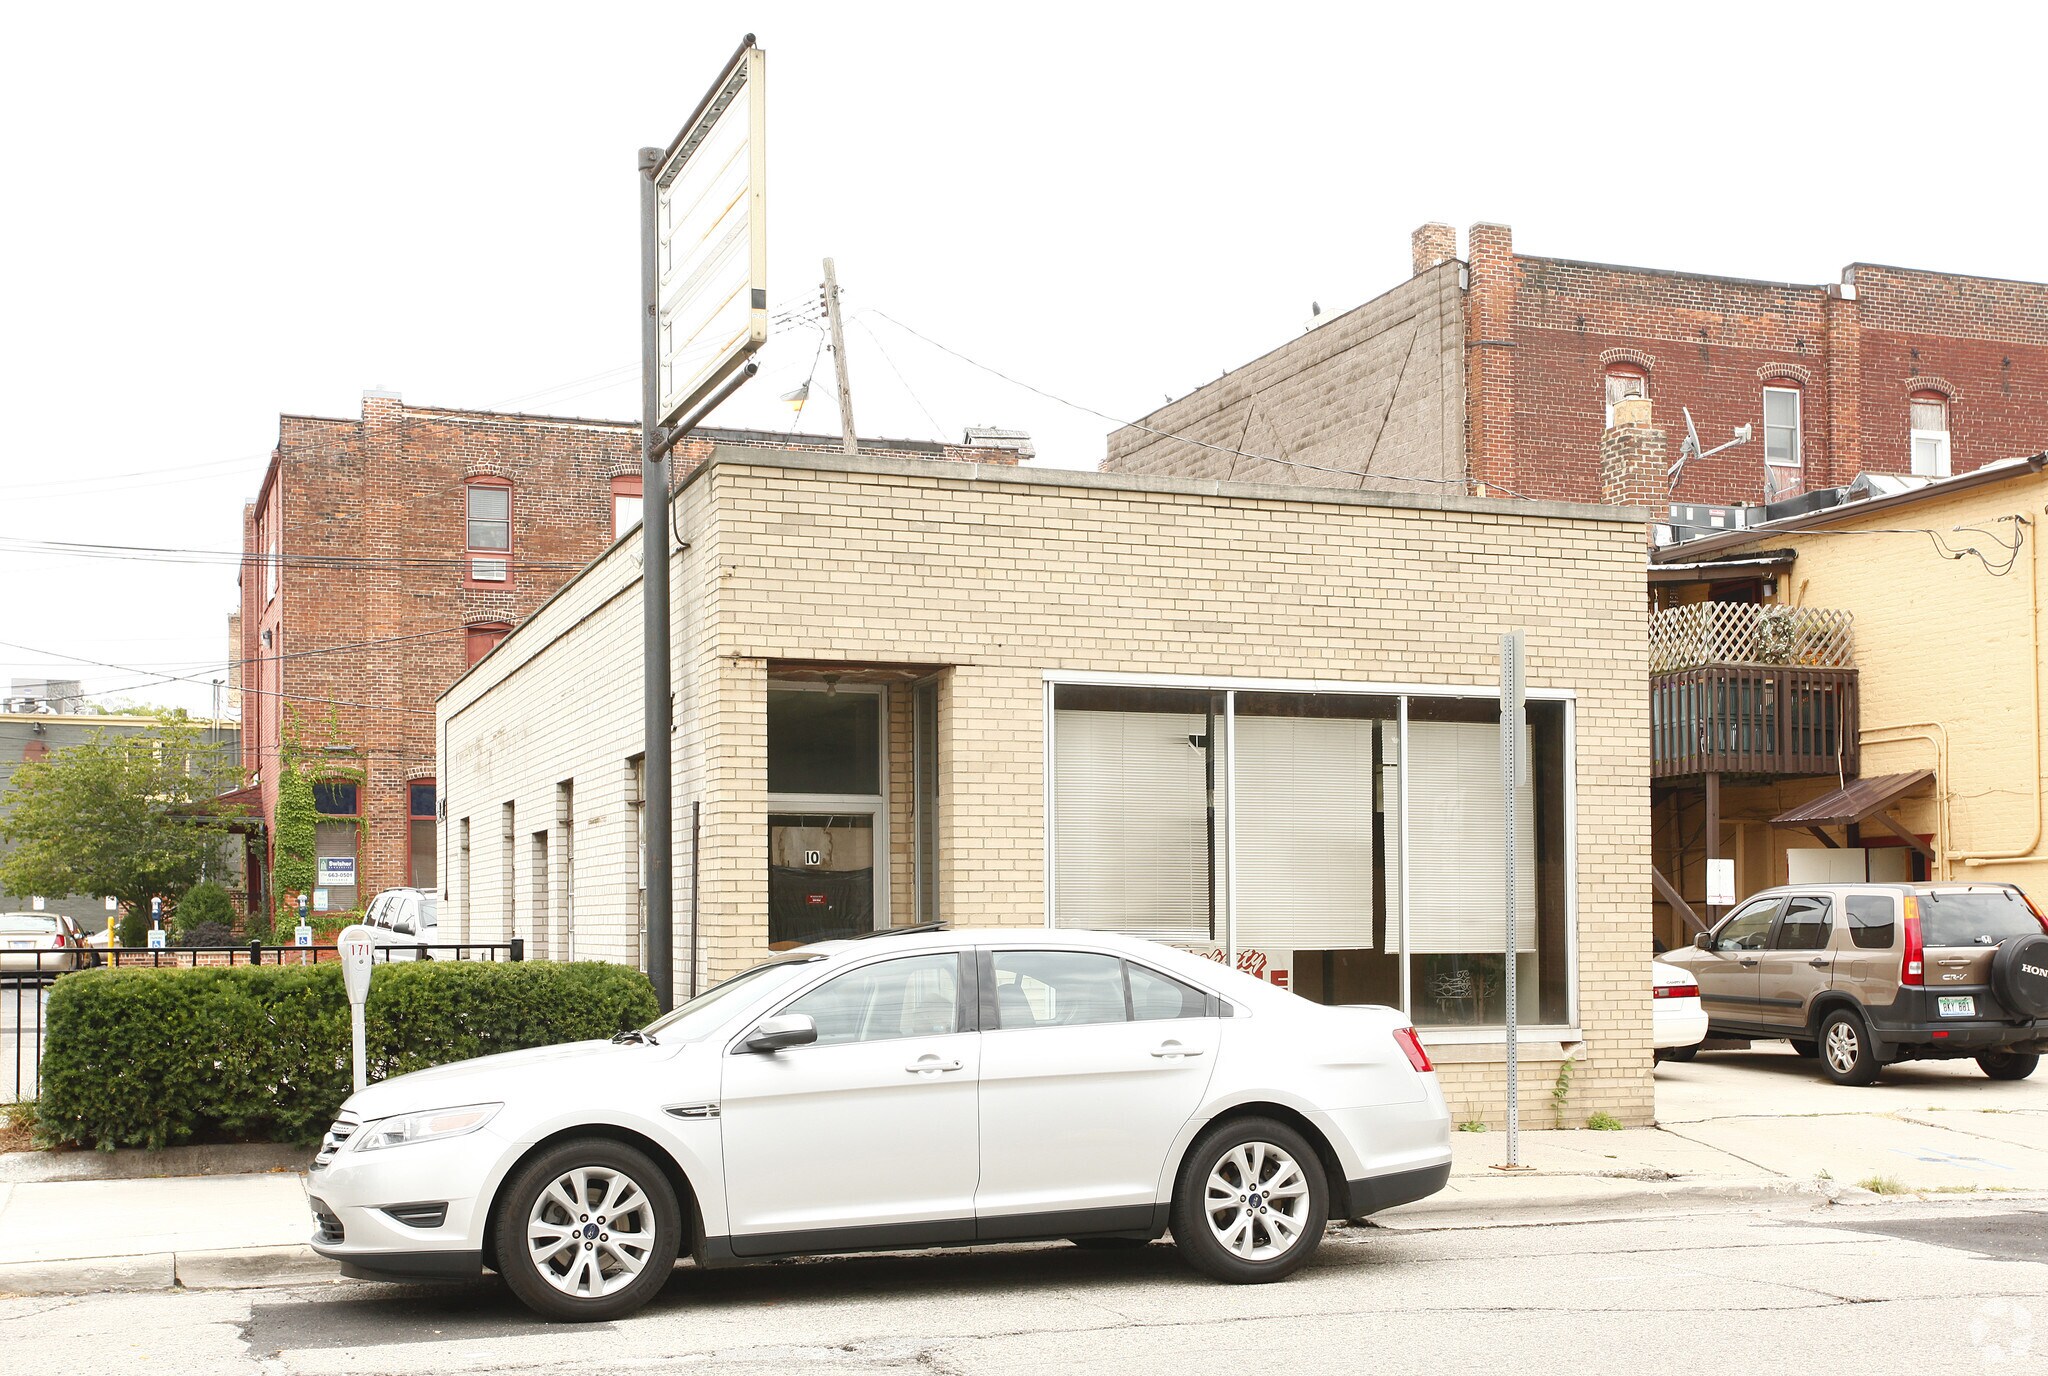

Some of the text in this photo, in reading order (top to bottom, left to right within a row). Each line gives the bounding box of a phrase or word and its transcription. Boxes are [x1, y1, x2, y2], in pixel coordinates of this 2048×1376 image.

[806, 851, 819, 864] 10
[352, 944, 369, 956] 171
[1942, 973, 1967, 981] CR-V
